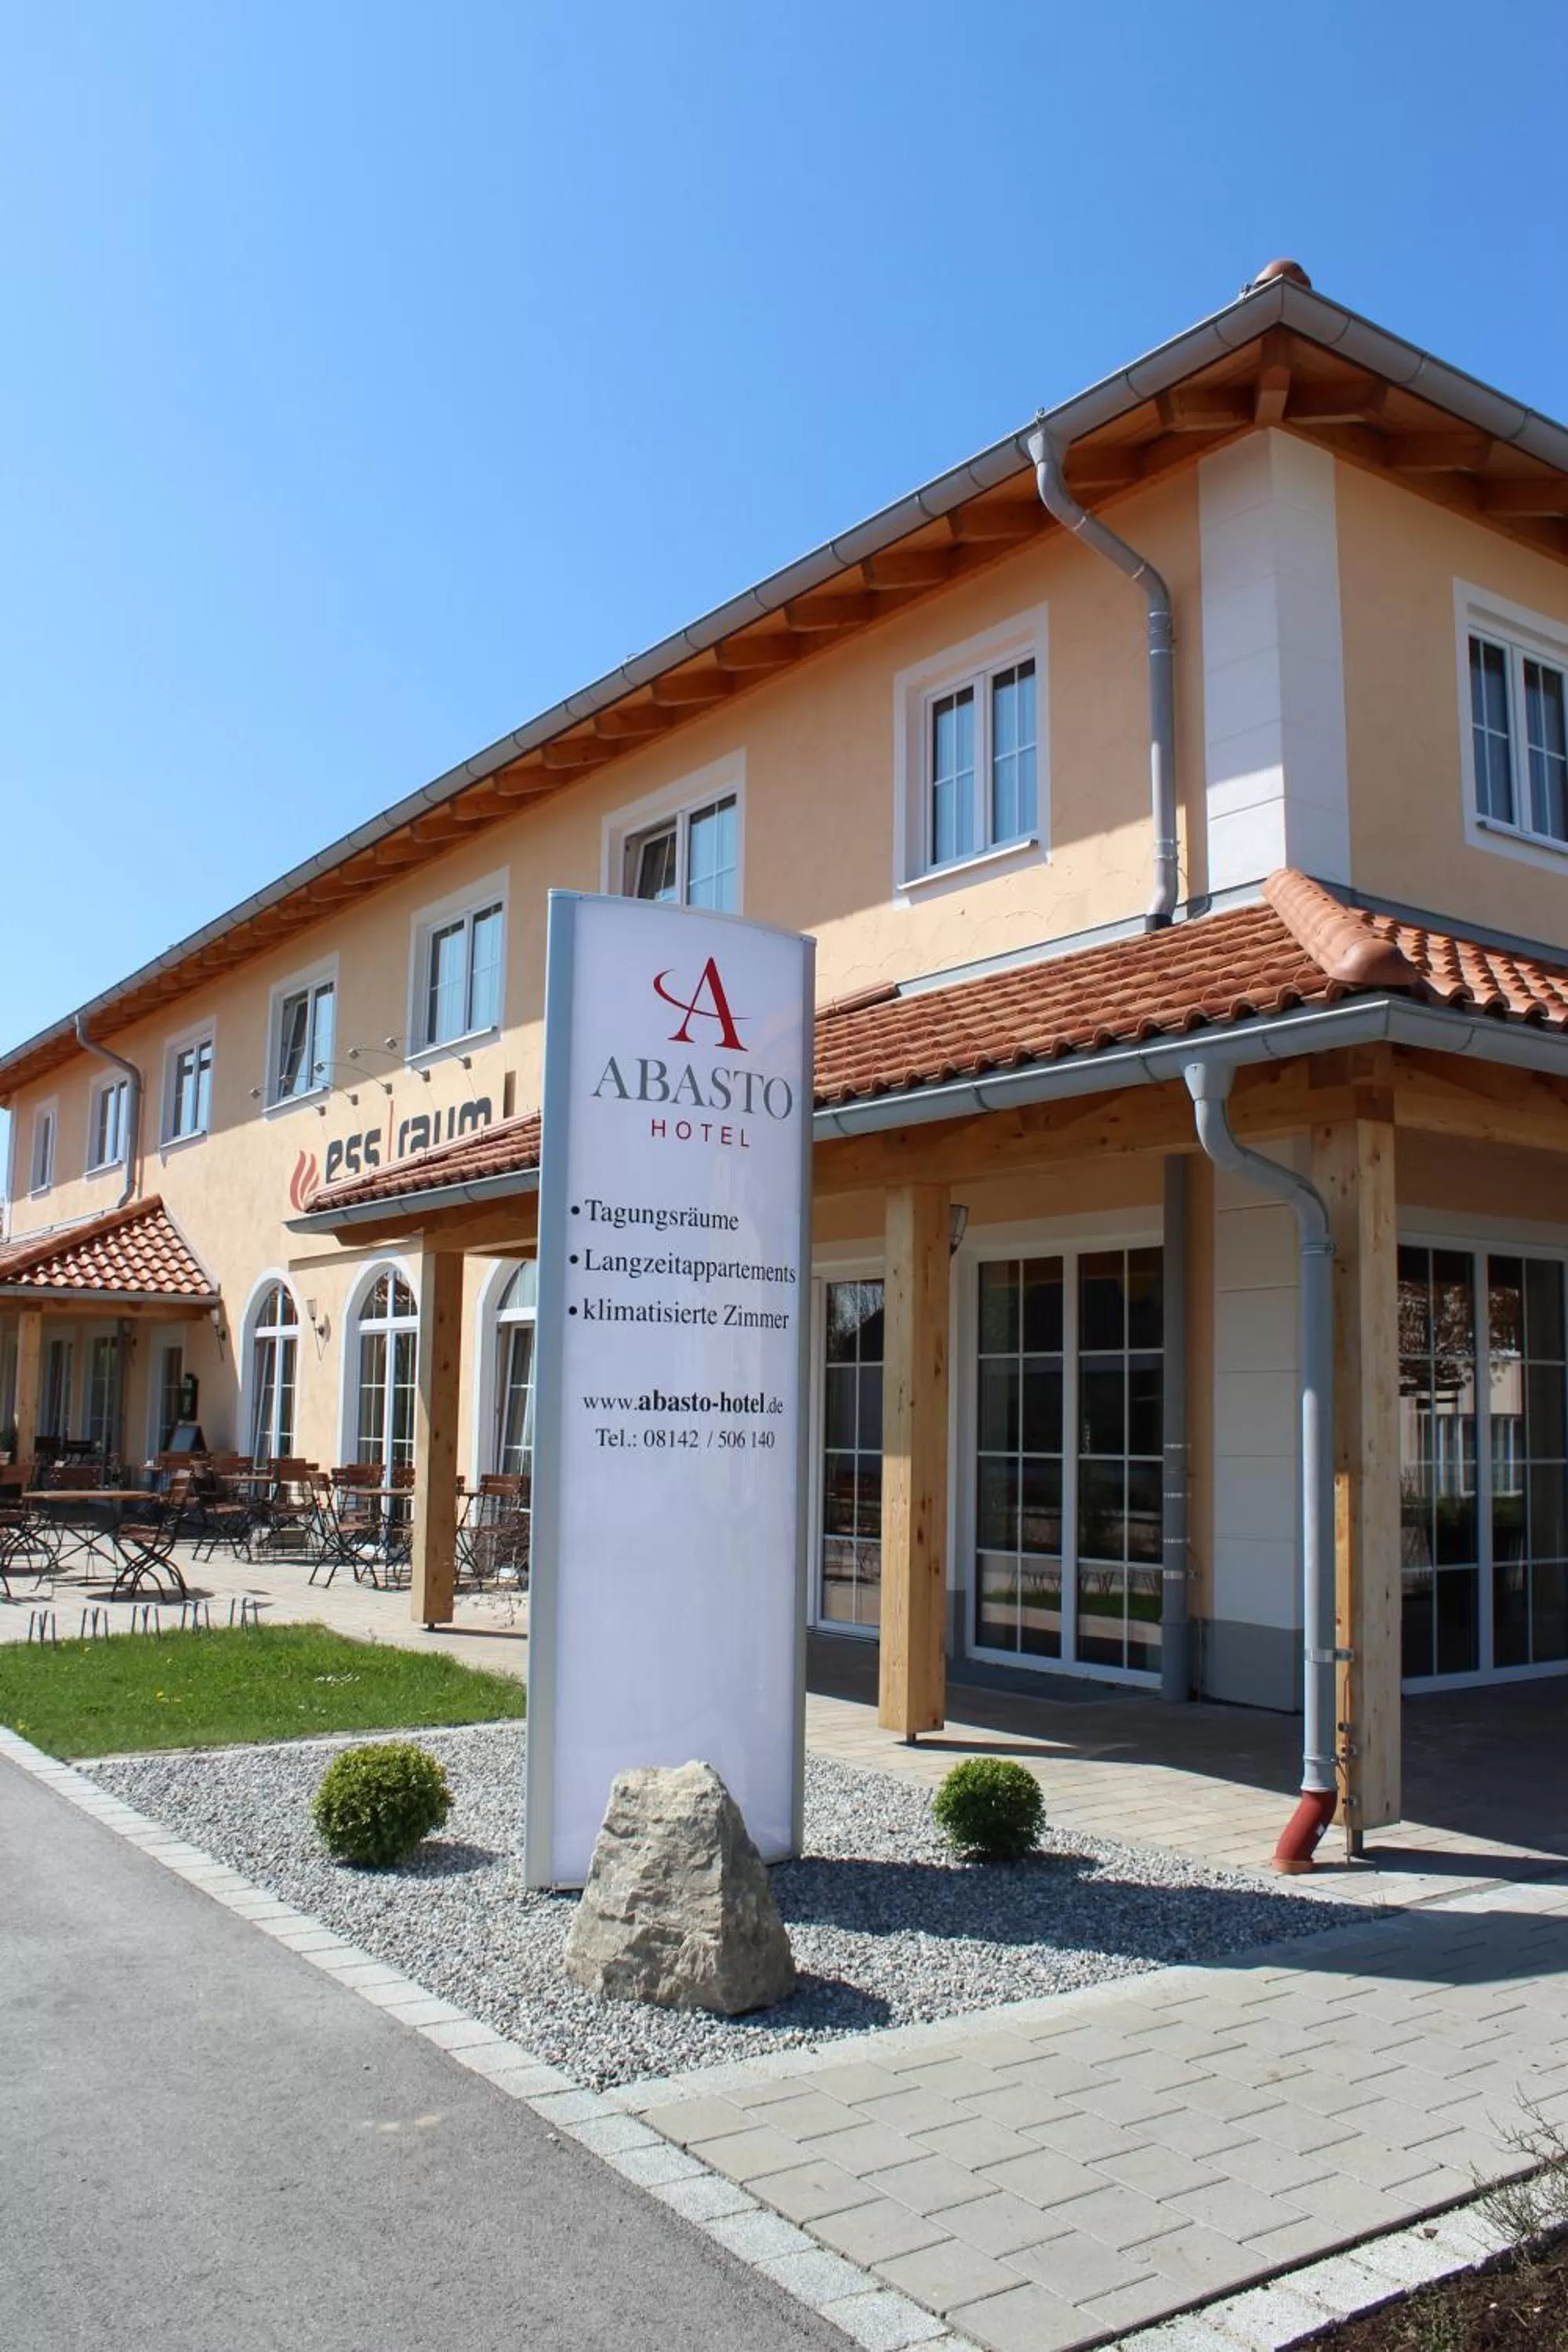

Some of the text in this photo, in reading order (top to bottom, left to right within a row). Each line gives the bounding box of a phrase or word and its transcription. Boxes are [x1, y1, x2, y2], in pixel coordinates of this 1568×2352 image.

[590, 1054, 793, 1120] ABASTO
[652, 1119, 750, 1148] HOTEL
[584, 1199, 739, 1232] Tagungsräume
[584, 1248, 797, 1284] Langzeitappartements
[583, 1298, 789, 1330] klimatisierte Zimmer
[583, 1388, 784, 1414] www.abasto-hotel.de
[595, 1428, 637, 1448] Tel.:
[643, 1429, 699, 1448] 08142
[717, 1430, 746, 1449] 506
[752, 1431, 775, 1449] 140
